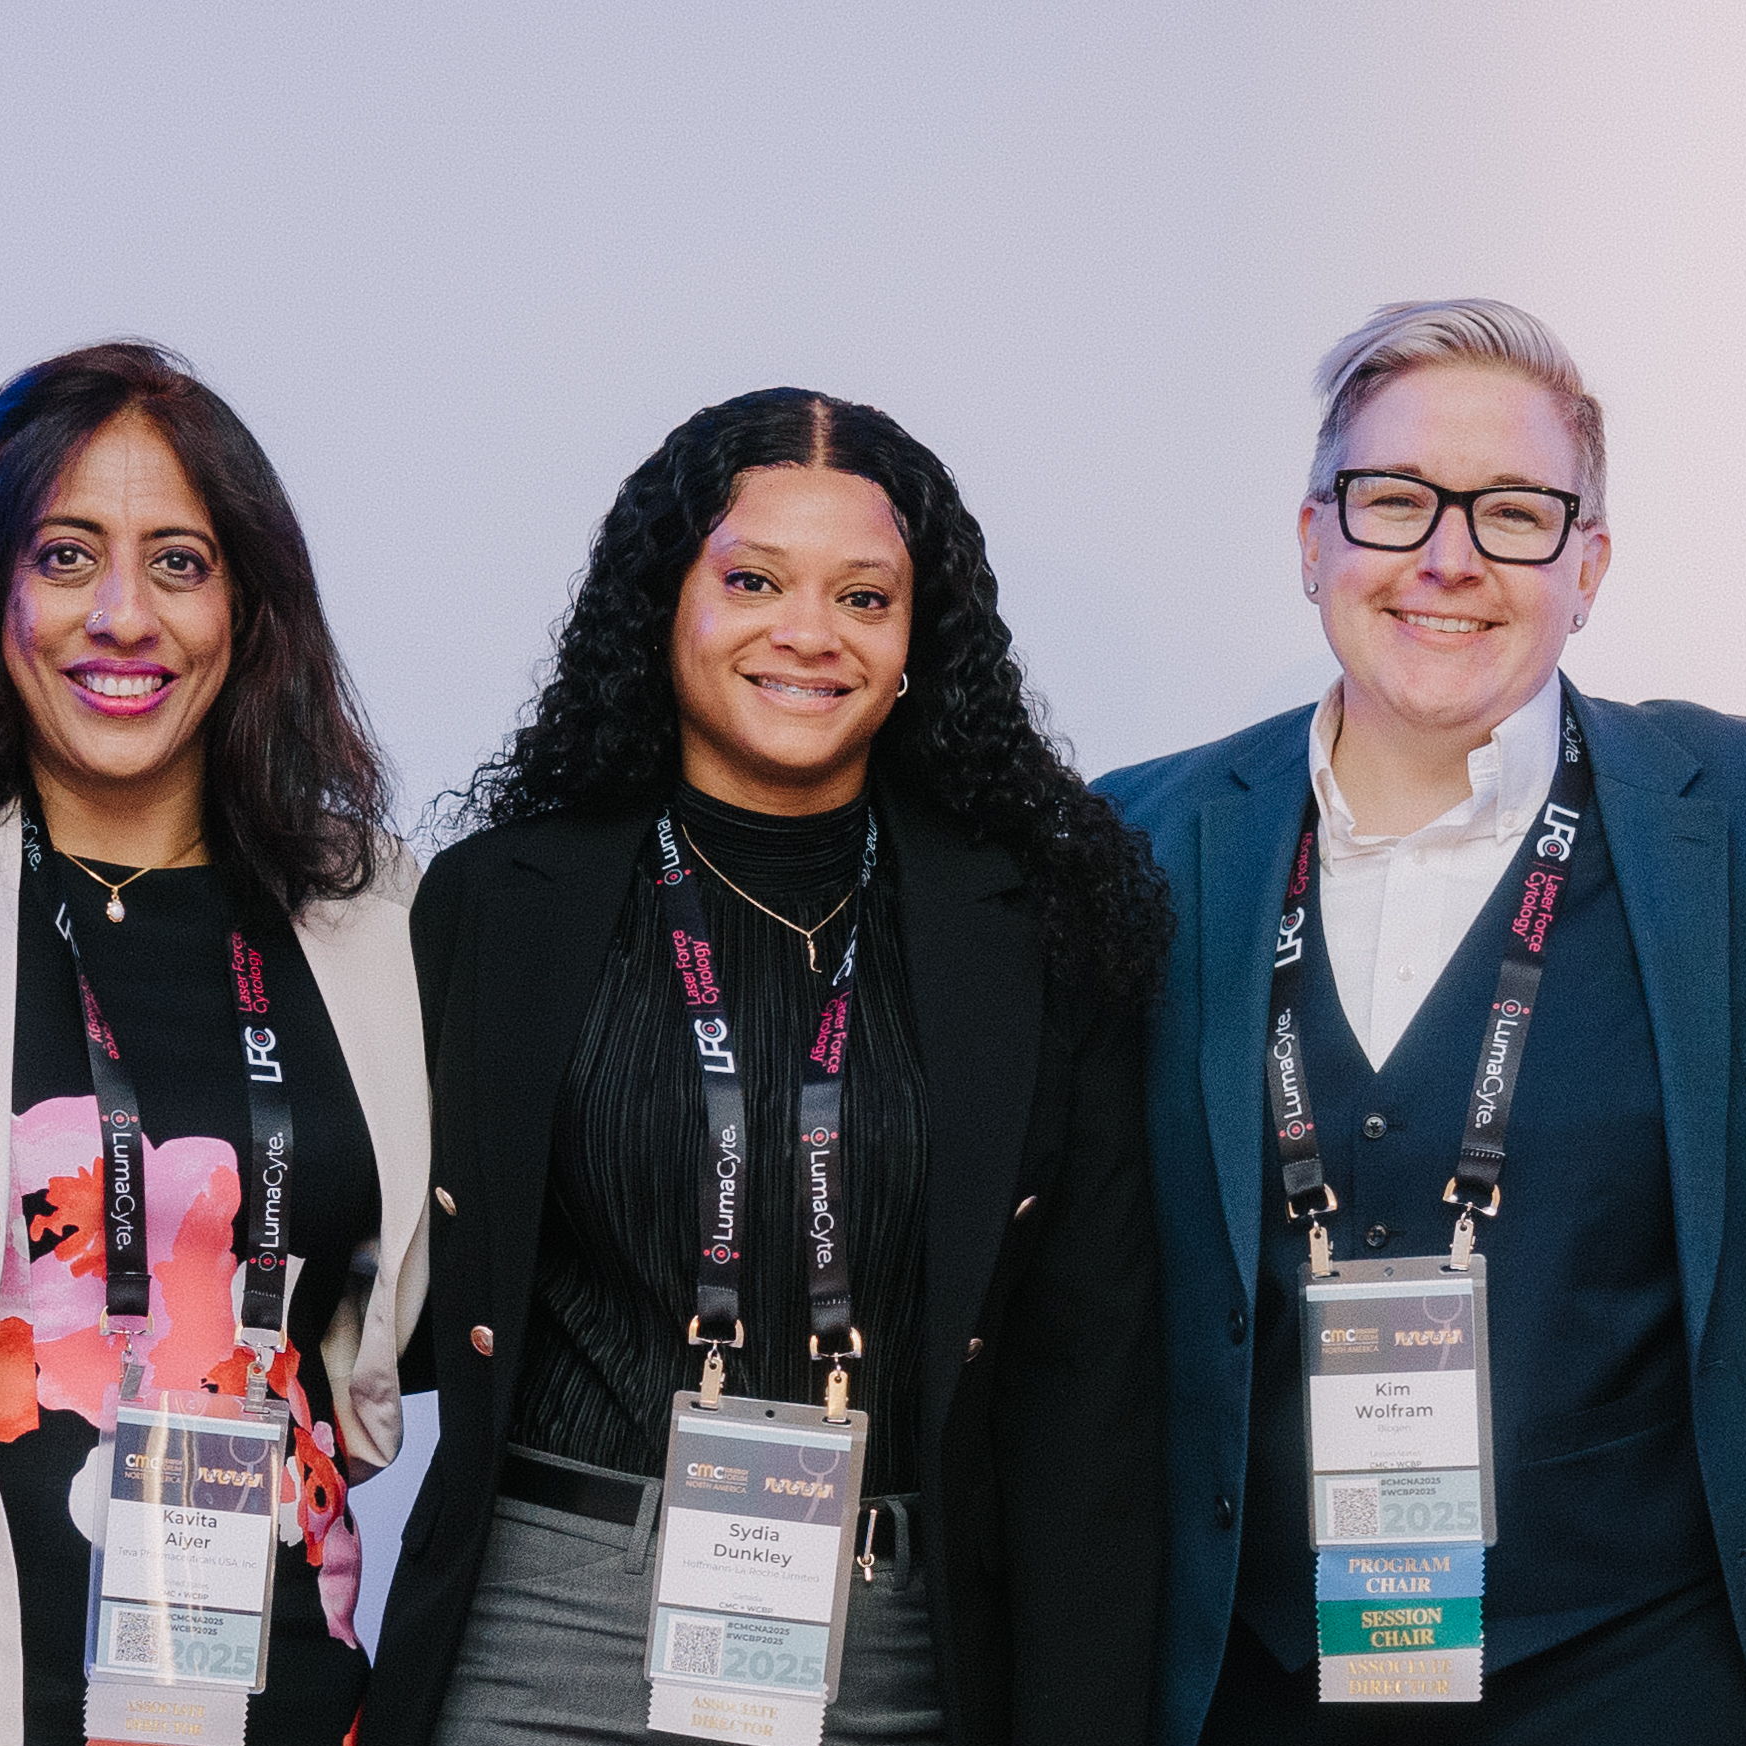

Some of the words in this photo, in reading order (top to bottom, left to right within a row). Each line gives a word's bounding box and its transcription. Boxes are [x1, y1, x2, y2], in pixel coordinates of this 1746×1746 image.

[1537, 802, 1580, 862] LFC
[1540, 875, 1564, 911] Laser
[1513, 871, 1547, 936] Cytology
[1275, 907, 1305, 968] LFC
[1529, 911, 1553, 952] Force
[232, 932, 246, 972] Force
[673, 930, 692, 970] Force
[248, 948, 270, 1013] Cytology
[693, 940, 719, 1004] Cytology
[237, 973, 252, 1012] Laser
[680, 969, 701, 1006] Laser
[810, 999, 838, 1062] Cytology
[244, 1026, 283, 1082] LFC
[694, 1018, 735, 1074] LFC
[827, 1031, 847, 1074] Force
[1321, 1329, 1355, 1343] cmc
[1348, 1345, 1379, 1353] AMERICA
[1376, 1382, 1410, 1396] Kim
[1355, 1404, 1433, 1418] Wolfram
[1378, 1424, 1411, 1433] Biogen
[687, 1463, 725, 1479] cmc
[686, 1480, 710, 1489] NORTH
[713, 1484, 747, 1494] AMERICA
[1381, 1477, 1441, 1486] #CMCNA2025
[1381, 1488, 1436, 1496] #WCBP2025
[163, 1510, 217, 1528] Kavita
[1383, 1501, 1479, 1532] 2025
[729, 1523, 779, 1541] Sydia
[165, 1532, 211, 1551] Aiyer
[118, 1547, 137, 1557] Teva
[713, 1544, 792, 1568] Dunkley
[1349, 1556, 1451, 1573] PROGRAM
[749, 1567, 779, 1578] Roche
[782, 1572, 819, 1583] Limited
[1366, 1577, 1431, 1593] CHAIR
[732, 1592, 762, 1602] Canada
[719, 1602, 737, 1611] CMC
[747, 1605, 773, 1613] WCBP
[1361, 1607, 1442, 1629] SESSION
[727, 1623, 790, 1635] #CMCNA2025
[1370, 1628, 1435, 1647] CHAIR
[726, 1633, 783, 1645] #WCBP2025
[724, 1648, 823, 1685] 2025
[1347, 1659, 1452, 1675] ASSOCIATE
[1349, 1680, 1449, 1695] DIRECTOR
[125, 1700, 205, 1718] ASSOCIATE
[692, 1697, 778, 1719] ASSOCIATE
[126, 1718, 202, 1735] DIRECTOR
[691, 1714, 773, 1737] DIRECTOR
